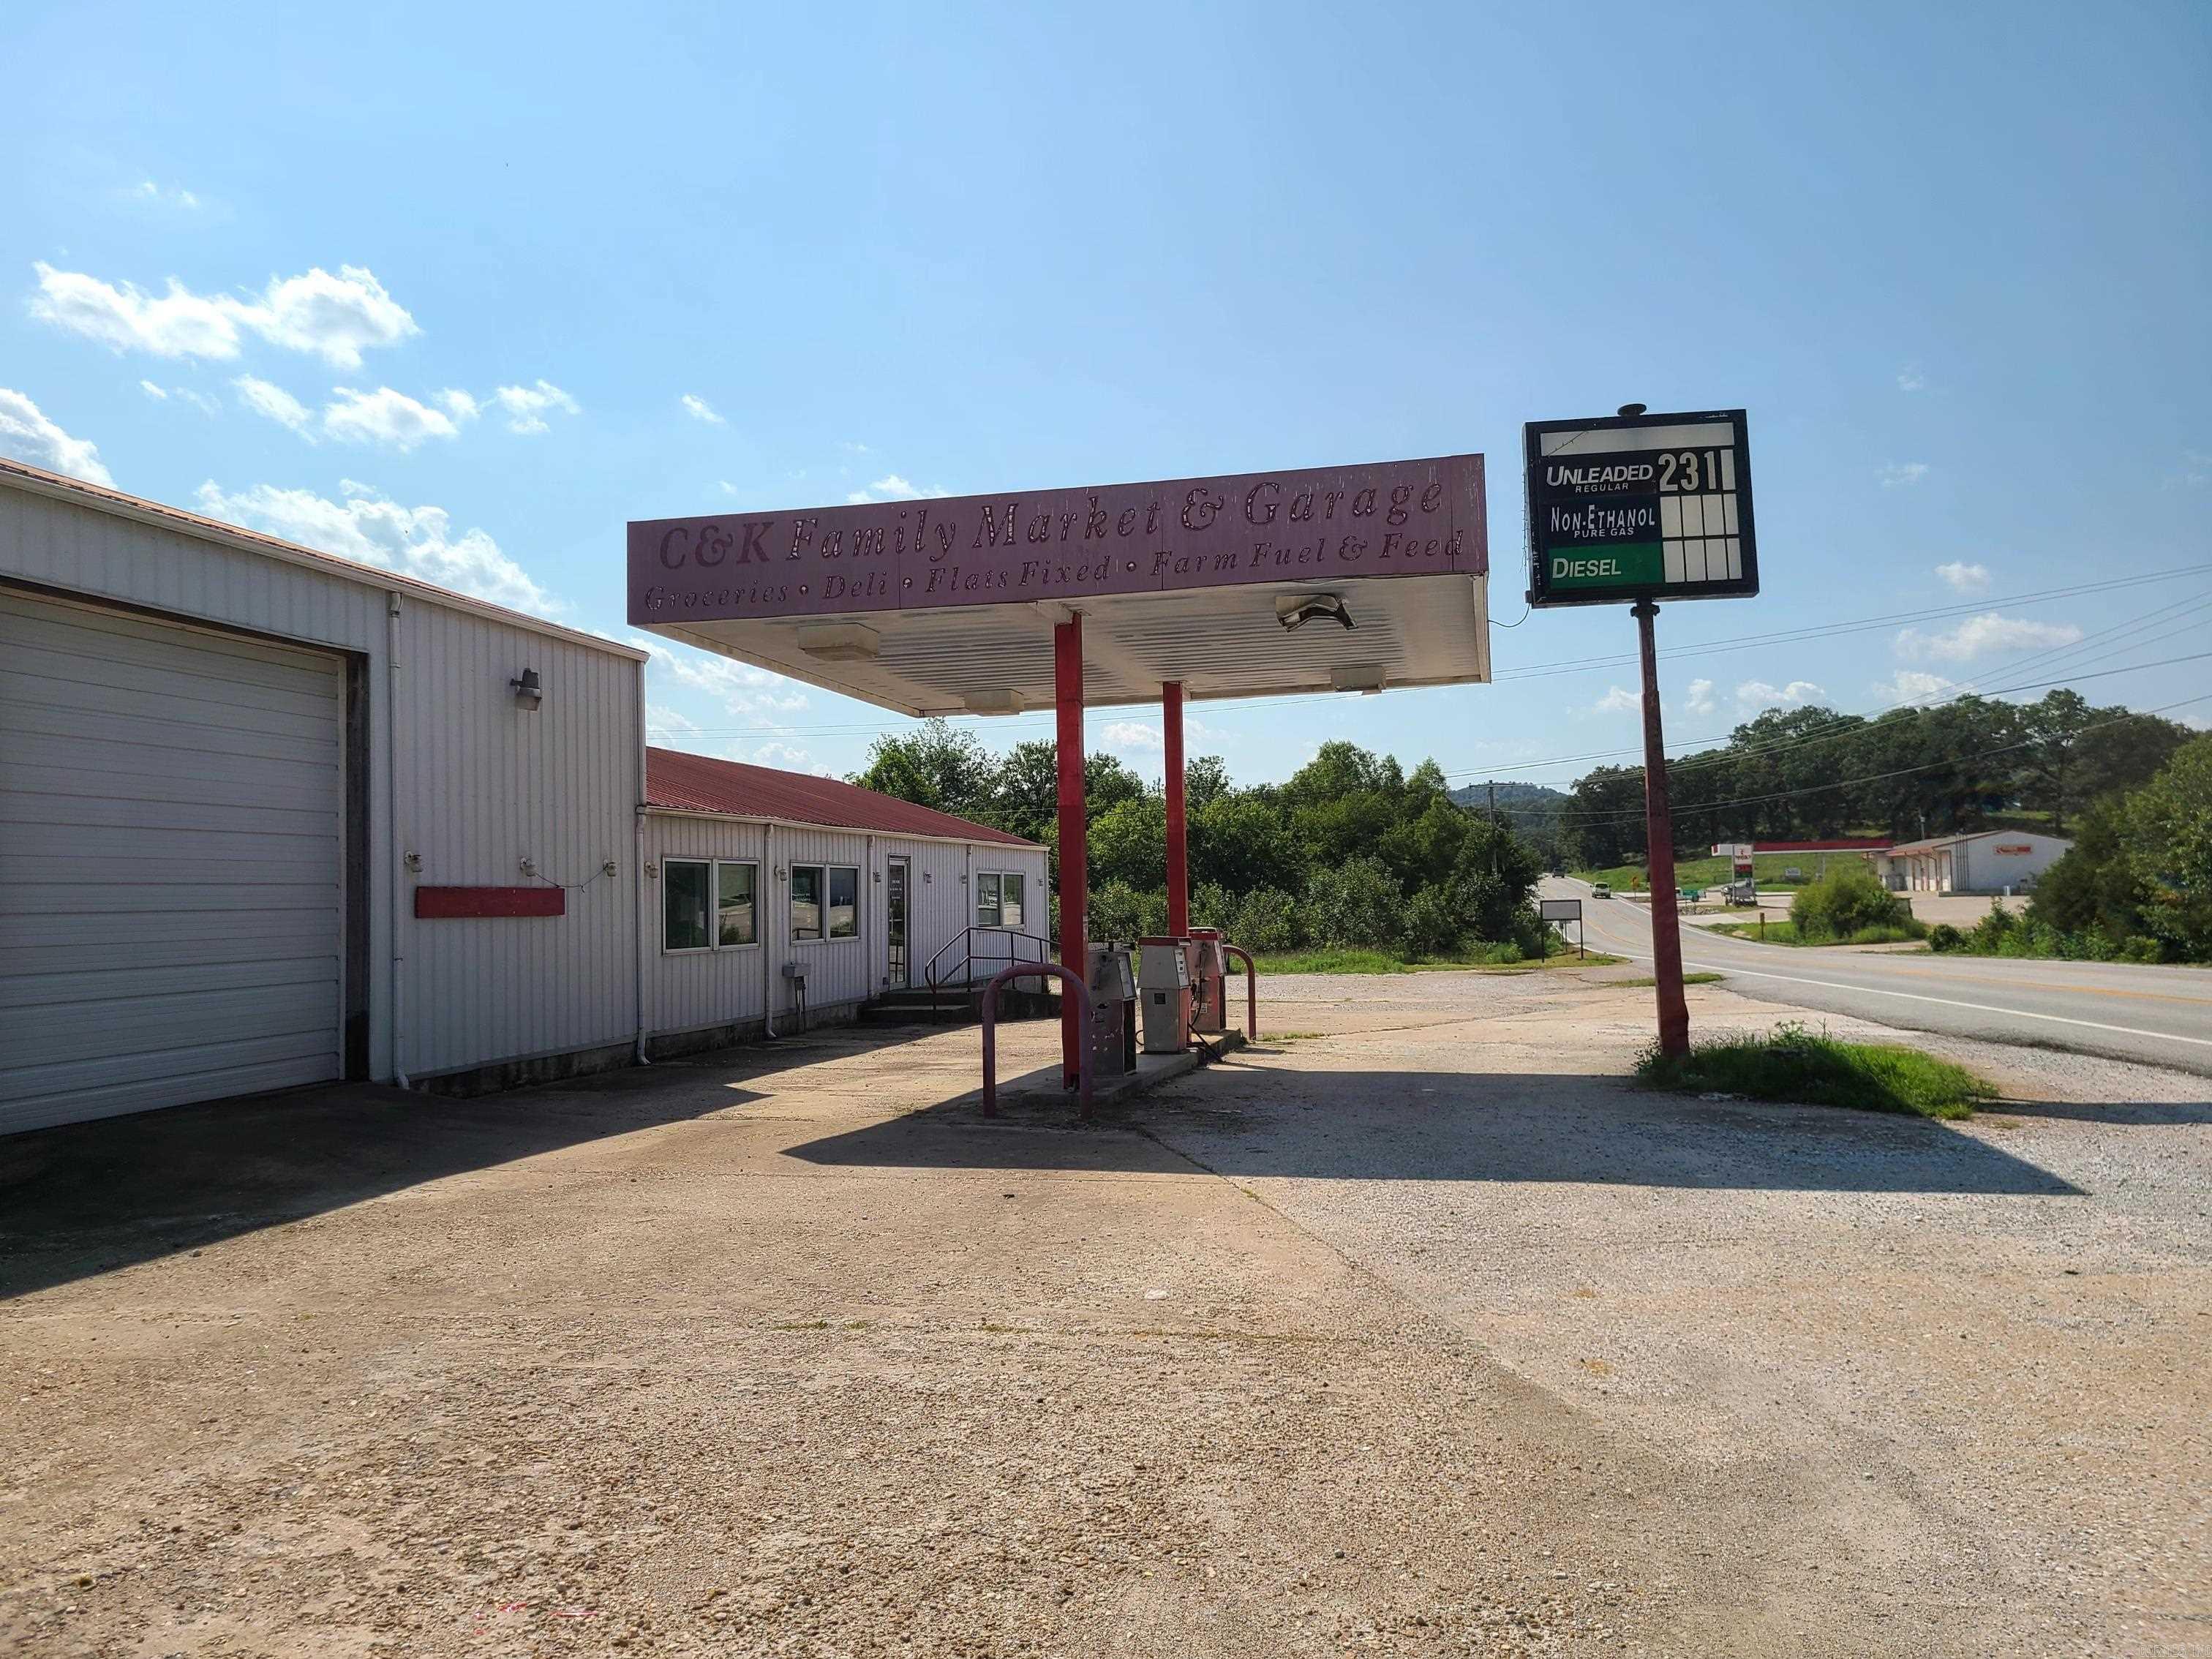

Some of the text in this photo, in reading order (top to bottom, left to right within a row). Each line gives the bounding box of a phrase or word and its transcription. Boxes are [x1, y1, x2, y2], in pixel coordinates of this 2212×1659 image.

[1546, 451, 1717, 491] UNLEADED 231
[1575, 483, 1629, 493] REGULAR
[660, 482, 1441, 569] C&K Family Market & Garage
[1573, 528, 1634, 538] PURE GAS
[645, 530, 1463, 610] Groceries Deli Flats Fixed Farm Fuel & Feed
[1551, 558, 1622, 579] DIESEL
